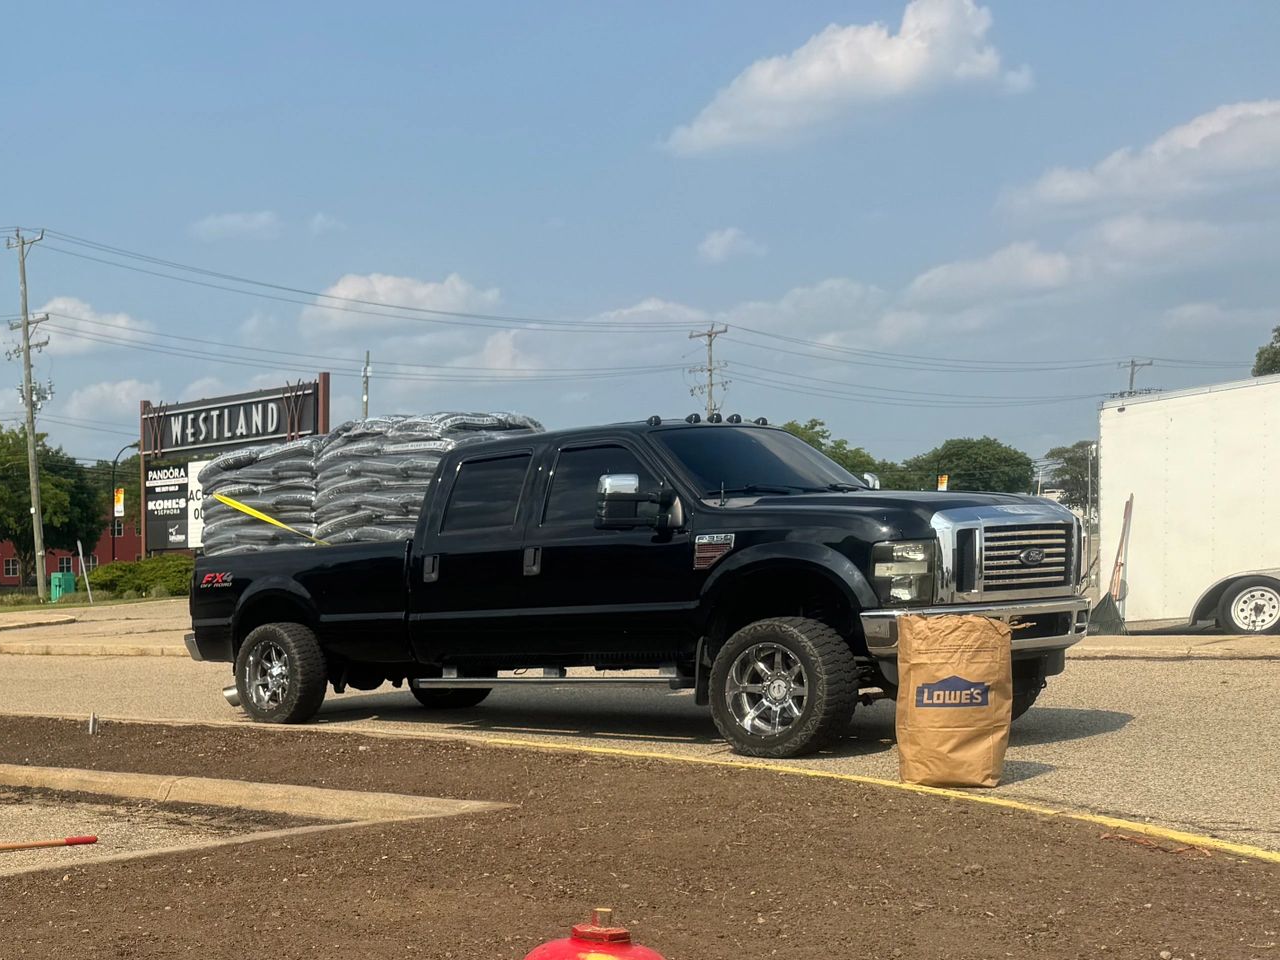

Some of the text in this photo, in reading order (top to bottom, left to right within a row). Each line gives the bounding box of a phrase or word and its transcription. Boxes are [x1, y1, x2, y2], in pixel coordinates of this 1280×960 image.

[171, 402, 280, 445] WESTLAND
[148, 498, 186, 510] KOHL'S
[202, 572, 234, 583] FX4
[923, 688, 983, 704] LOWE'S
